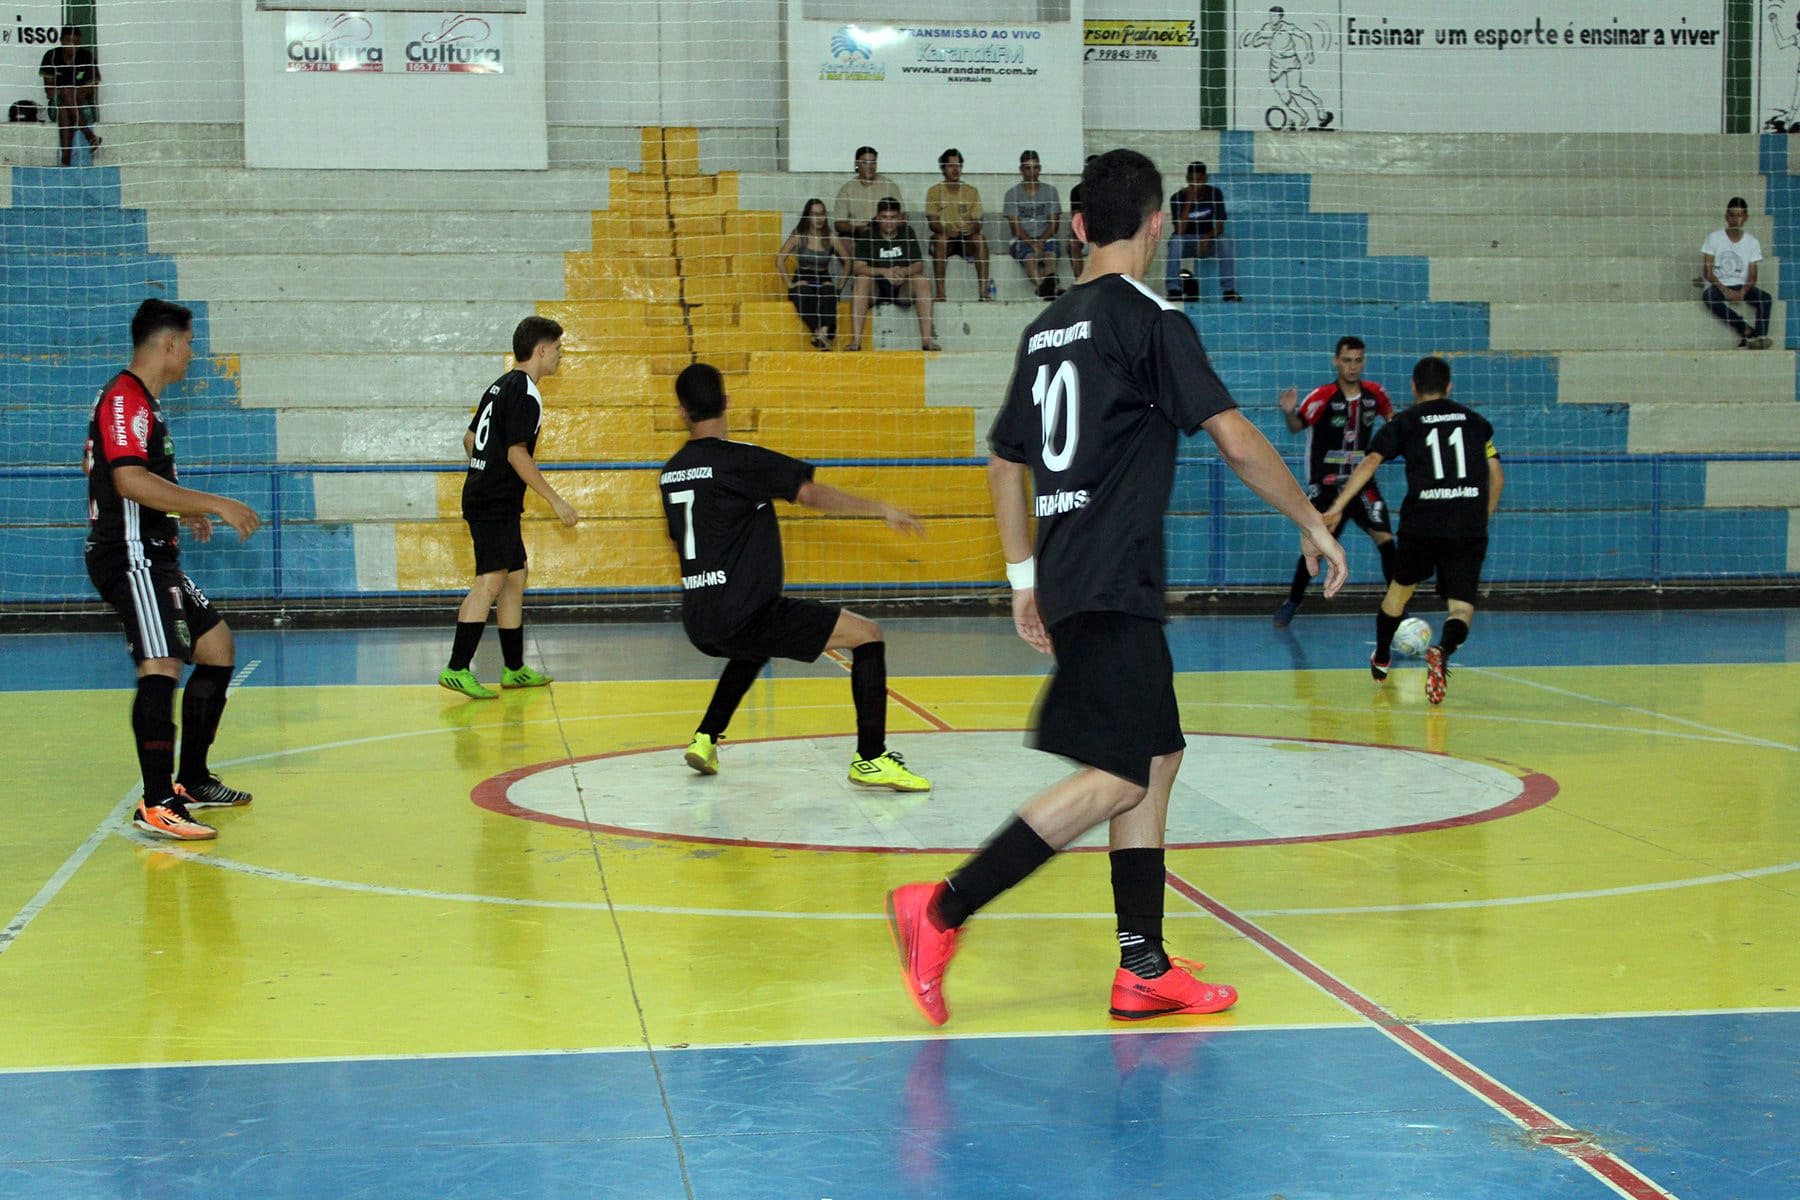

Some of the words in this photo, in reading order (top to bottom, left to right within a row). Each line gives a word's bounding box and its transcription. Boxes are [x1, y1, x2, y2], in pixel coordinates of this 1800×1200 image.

[991, 30, 1008, 39] AO
[1012, 30, 1041, 40] VIVO
[1347, 17, 1425, 45] Ensinar
[1435, 28, 1467, 45] um
[1474, 17, 1559, 50] esporte
[1564, 21, 1574, 45] é
[1580, 17, 1650, 45] ensinar
[1654, 28, 1665, 45] a
[1670, 17, 1720, 45] viver
[287, 40, 383, 62] Cultura
[405, 41, 500, 62] Cultura
[902, 65, 1038, 76] www.karandafm.com.br
[475, 400, 494, 451] 6
[1031, 360, 1080, 472] 10
[1425, 426, 1467, 479] 11
[687, 466, 713, 481] SOUZA
[668, 489, 696, 560] 7
